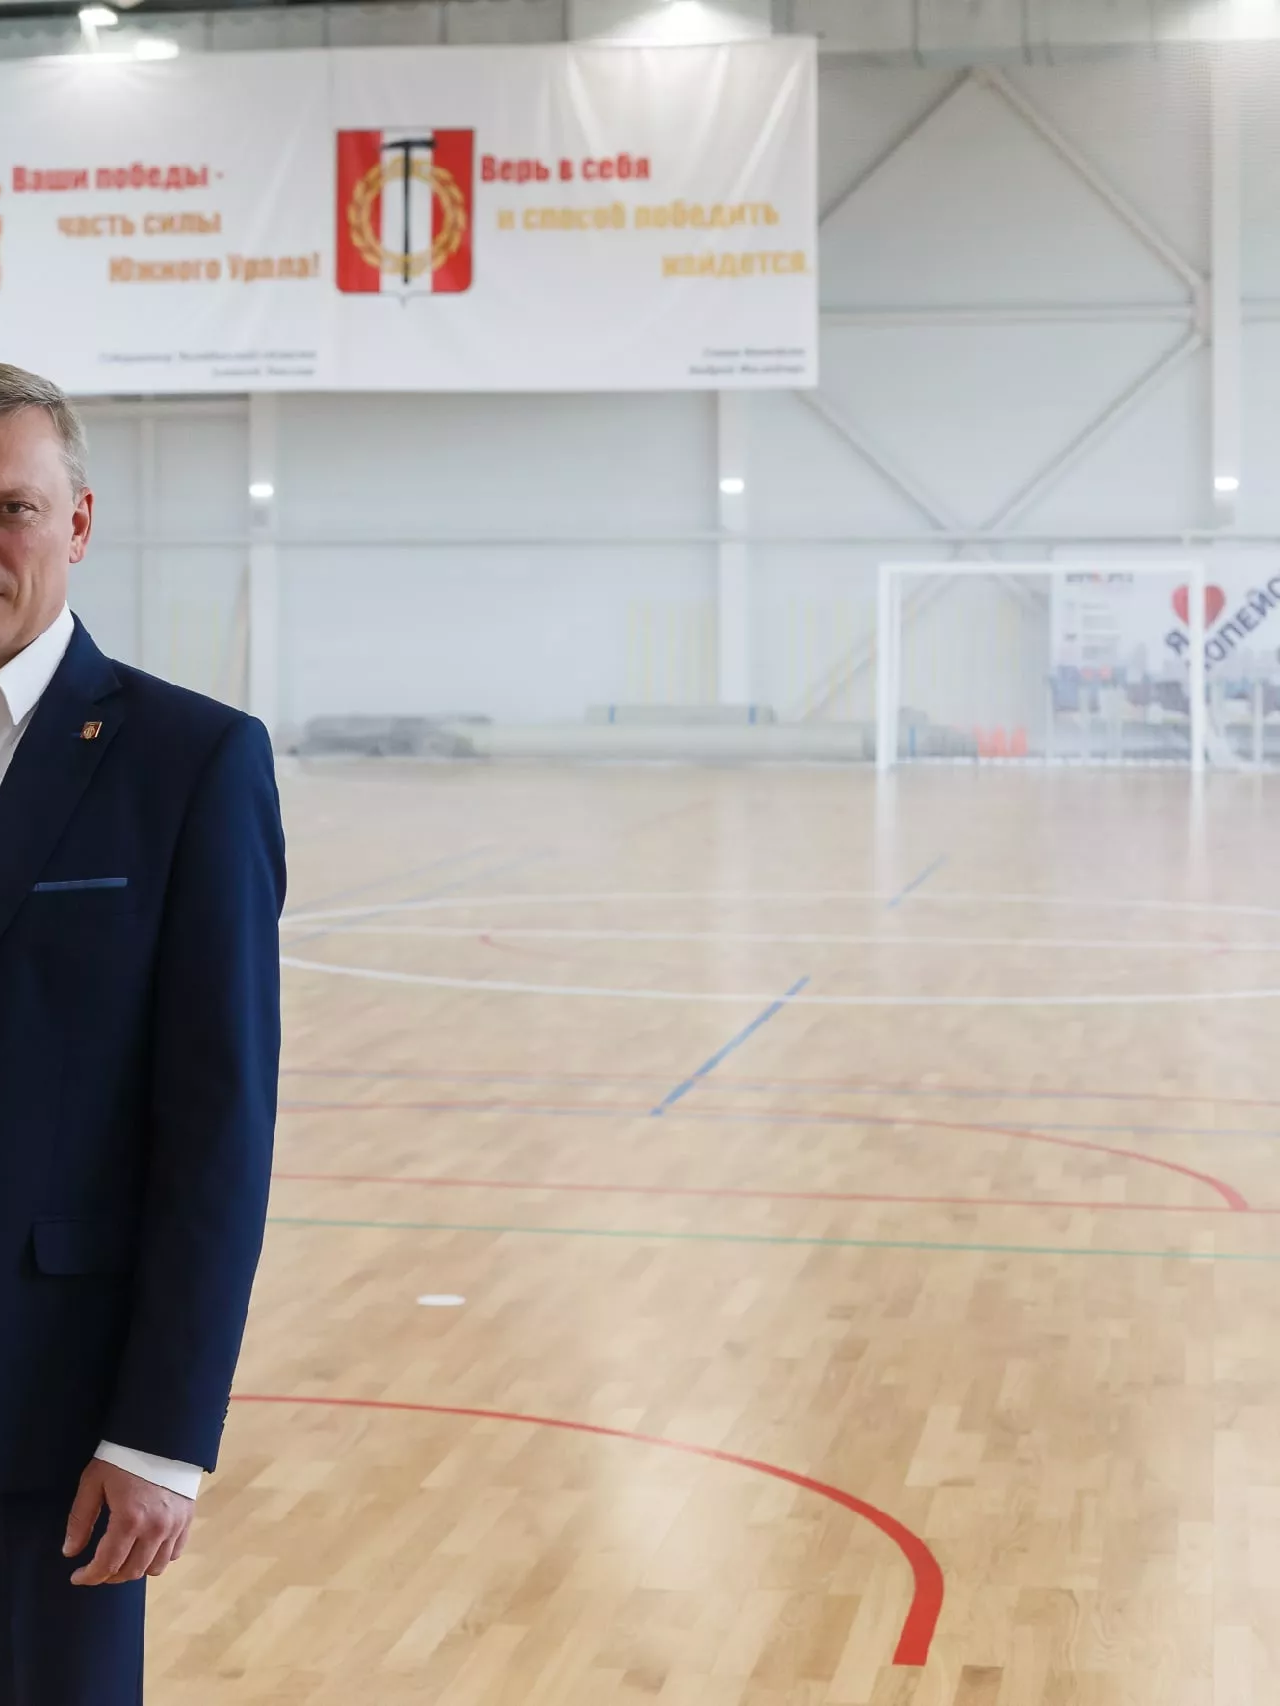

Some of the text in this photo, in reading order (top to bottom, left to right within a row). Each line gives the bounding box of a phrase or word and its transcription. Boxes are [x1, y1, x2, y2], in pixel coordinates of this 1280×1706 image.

[11, 166, 89, 192] Ваши
[95, 161, 209, 191] победы
[481, 153, 651, 182] Верь в себя
[57, 212, 222, 237] часть силы
[522, 204, 626, 230] способ
[634, 200, 779, 230] победить
[109, 256, 220, 282] Южного
